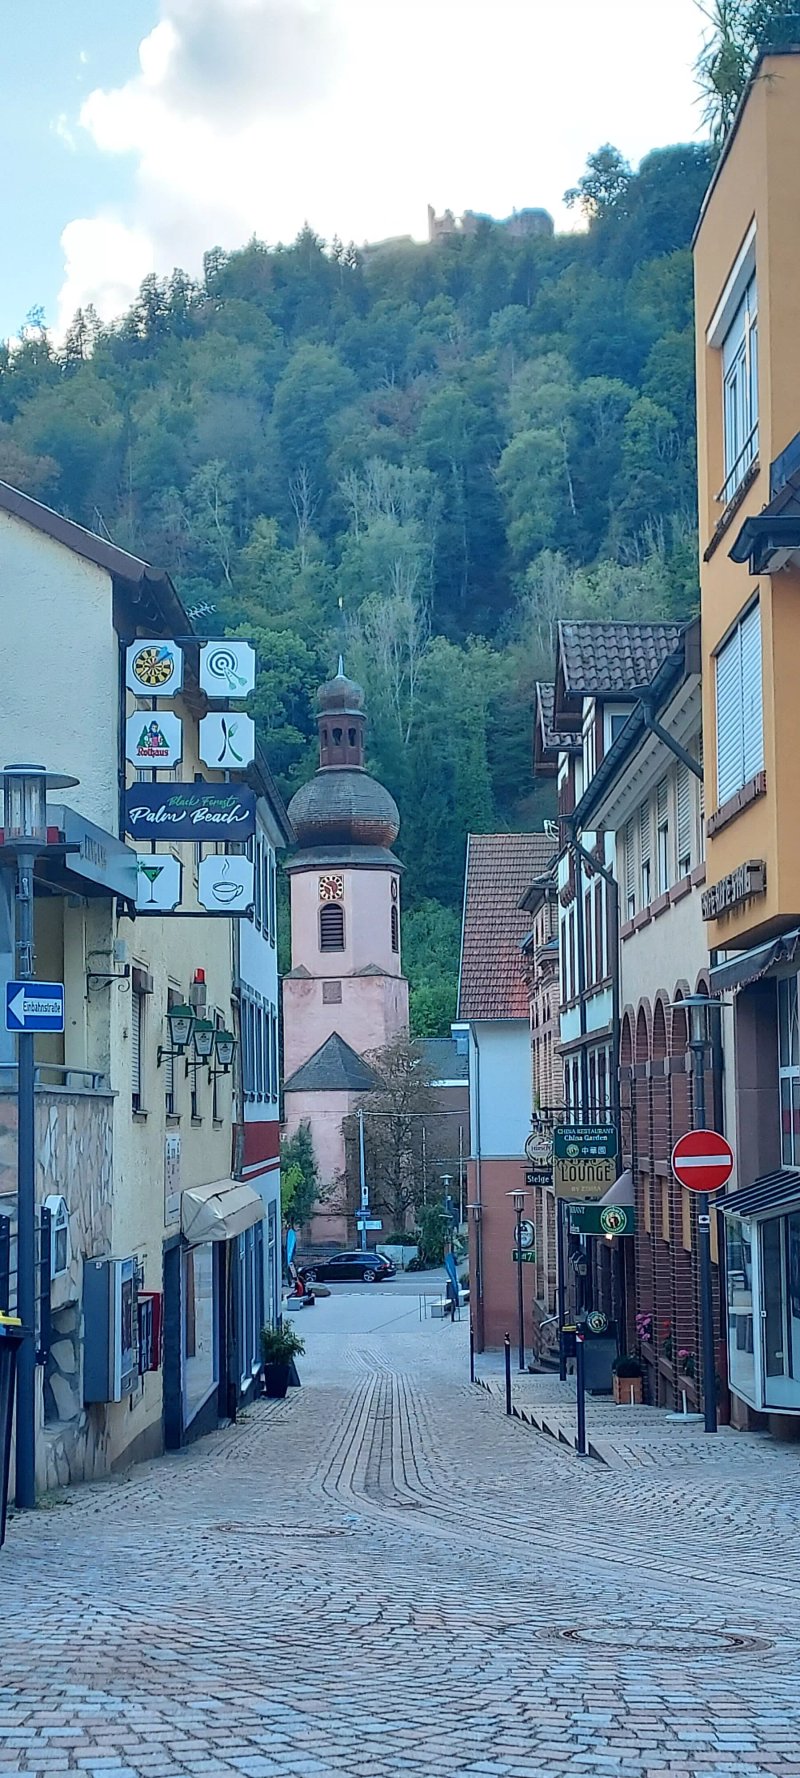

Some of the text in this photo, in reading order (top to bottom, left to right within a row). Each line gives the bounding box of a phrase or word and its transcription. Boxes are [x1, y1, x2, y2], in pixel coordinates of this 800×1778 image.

[167, 795, 239, 809] Black Forest
[129, 804, 249, 824] Palm Beach
[23, 1001, 61, 1013] Einbahnstraße
[561, 1165, 612, 1182] LOUNGE
